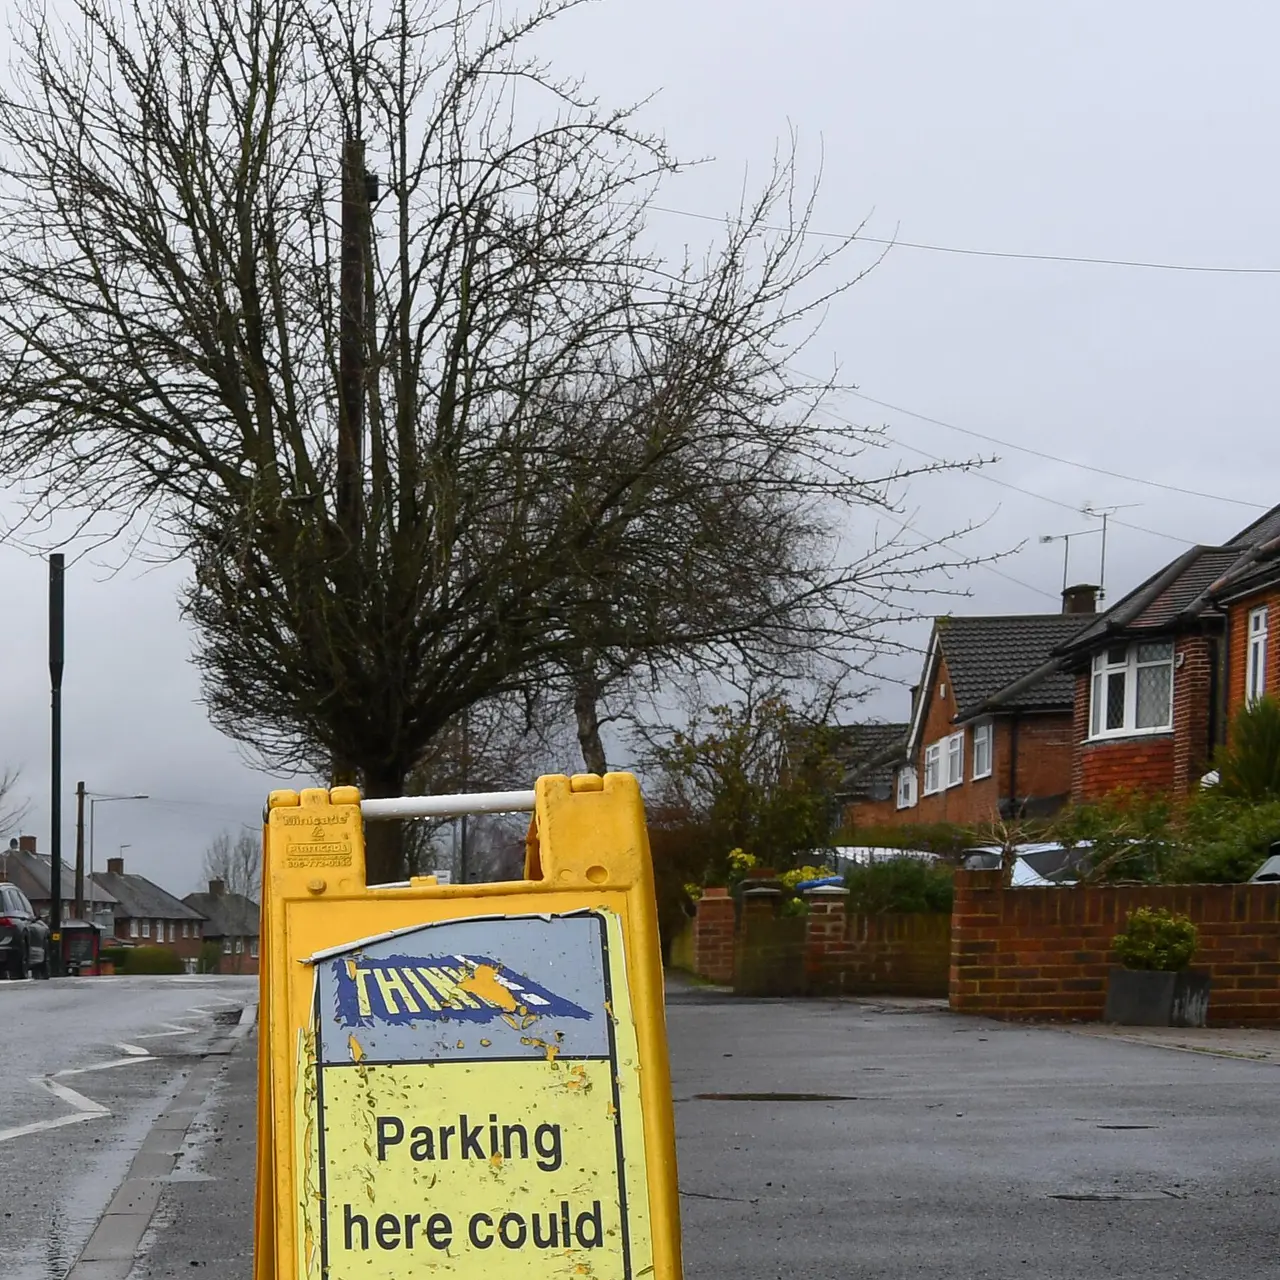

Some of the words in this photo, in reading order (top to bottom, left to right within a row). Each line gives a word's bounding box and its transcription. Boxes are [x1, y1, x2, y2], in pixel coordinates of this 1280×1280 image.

[376, 1113, 563, 1172] Parking
[343, 1203, 453, 1250] here
[468, 1200, 604, 1249] could
